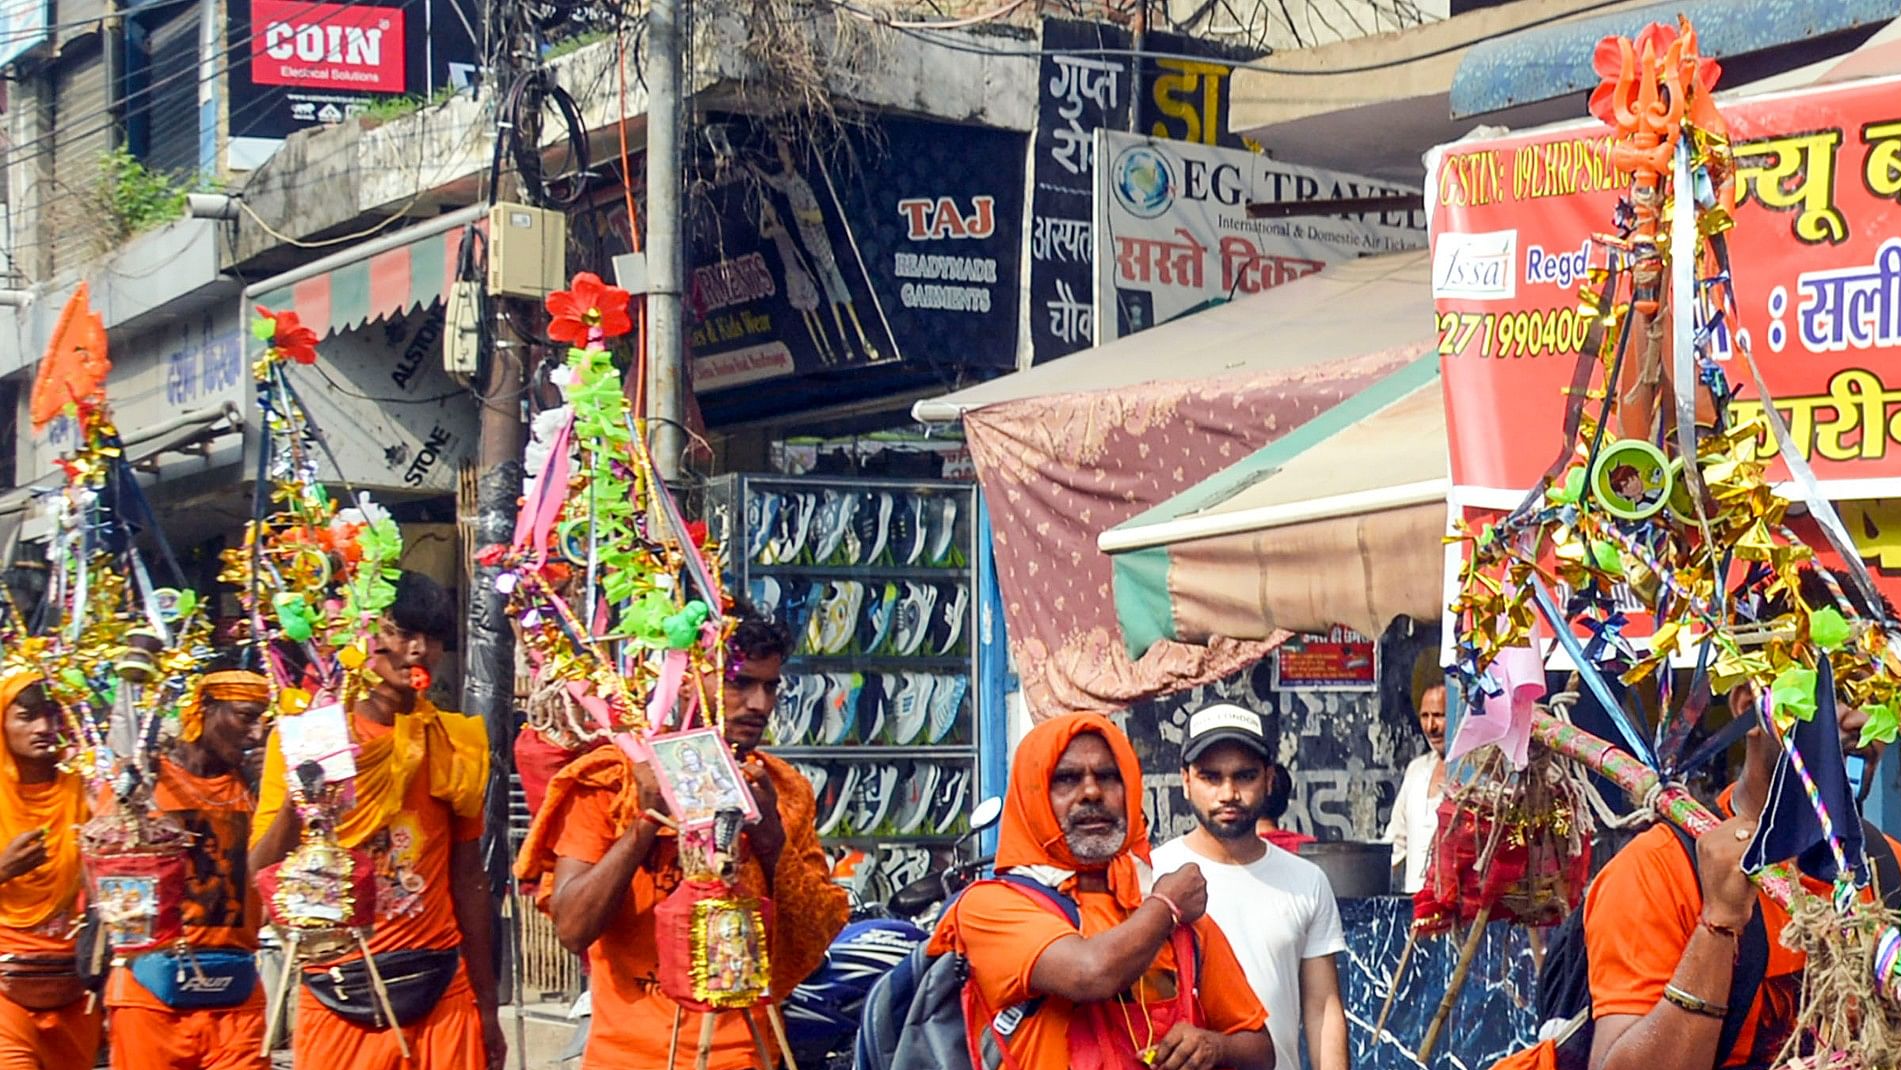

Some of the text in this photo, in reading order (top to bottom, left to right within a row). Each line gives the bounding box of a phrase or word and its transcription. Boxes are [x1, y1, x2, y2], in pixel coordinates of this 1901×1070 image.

[266, 21, 382, 66] COIN
[331, 68, 379, 83] Solutions
[1051, 54, 1125, 120] गुप्त
[1051, 119, 1094, 175] रो
[1184, 158, 1252, 208] EG.
[1439, 149, 1505, 207] GSTIN:
[898, 196, 995, 240] TAJ
[1218, 213, 1291, 238] International
[1306, 226, 1361, 247] Domestic
[1361, 234, 1381, 250] Air
[894, 252, 998, 283] READYMADE
[1115, 228, 1207, 289] सस्ते
[901, 282, 991, 313] GARMENTS
